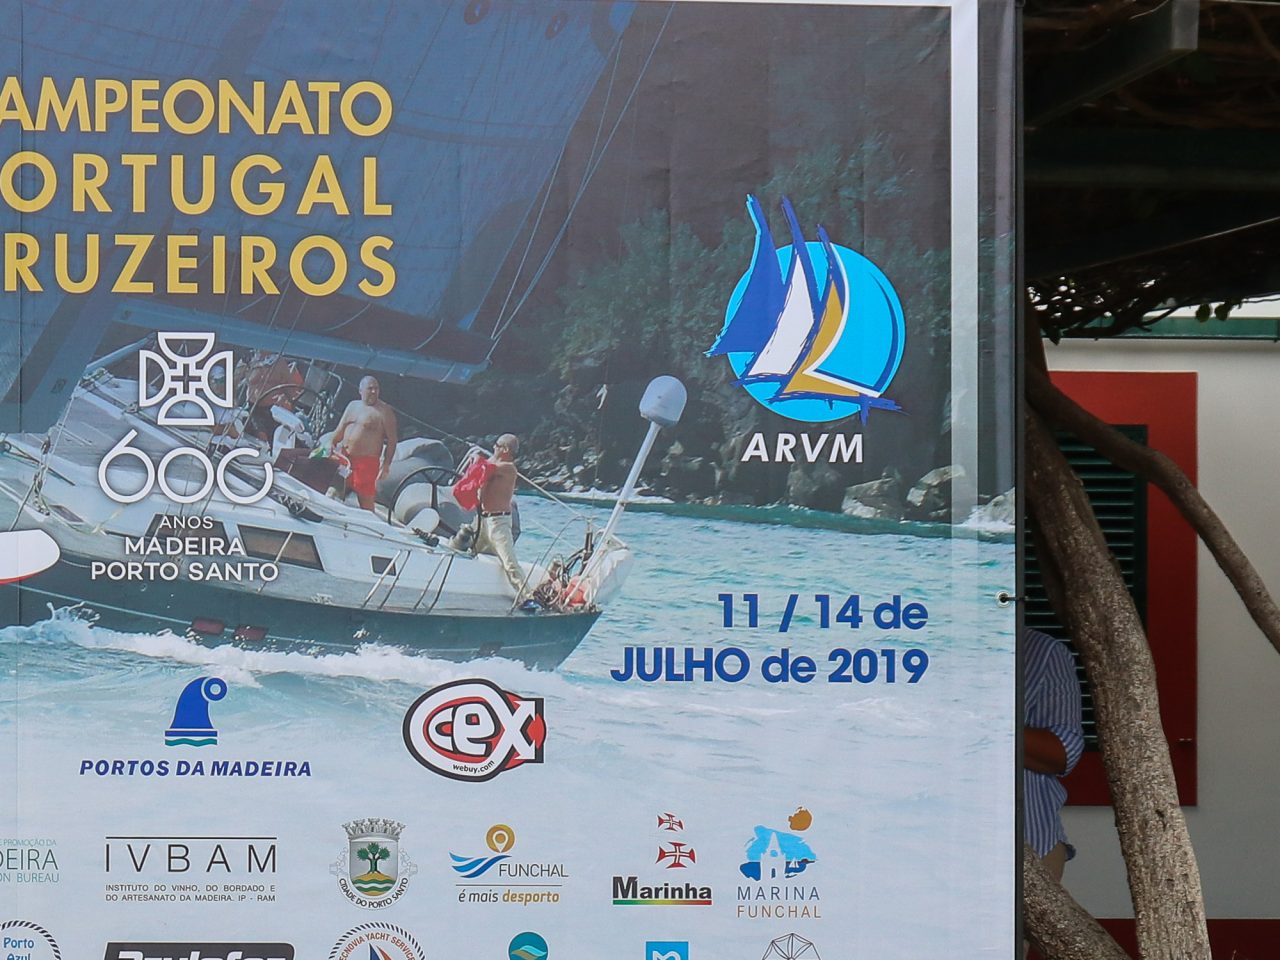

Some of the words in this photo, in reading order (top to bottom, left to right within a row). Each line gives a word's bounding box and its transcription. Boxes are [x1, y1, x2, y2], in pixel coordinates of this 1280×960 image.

[741, 432, 863, 463] ARVM
[159, 515, 213, 529] ANOS
[125, 536, 246, 556] MADEIRA
[91, 561, 179, 580] PORTO
[188, 562, 279, 581] SANTO
[718, 593, 759, 628] 11
[815, 594, 863, 629] 14
[873, 595, 929, 630] de
[610, 647, 751, 683] JULHO
[761, 648, 817, 683] de
[828, 648, 929, 684] 2019
[79, 760, 170, 777] PORTOS
[176, 761, 205, 777] DA
[210, 761, 312, 777] MADEIRA
[452, 760, 496, 774] webuy.com
[16, 873, 59, 883] BUREAU
[499, 864, 569, 877] FUNCHAL
[613, 876, 712, 900] Marinha
[737, 886, 820, 900] MARINA
[458, 890, 465, 902] é
[469, 890, 498, 902] mais
[502, 890, 560, 906] desporto
[737, 905, 821, 918] FUNCHAL
[3, 937, 34, 948] Porto
